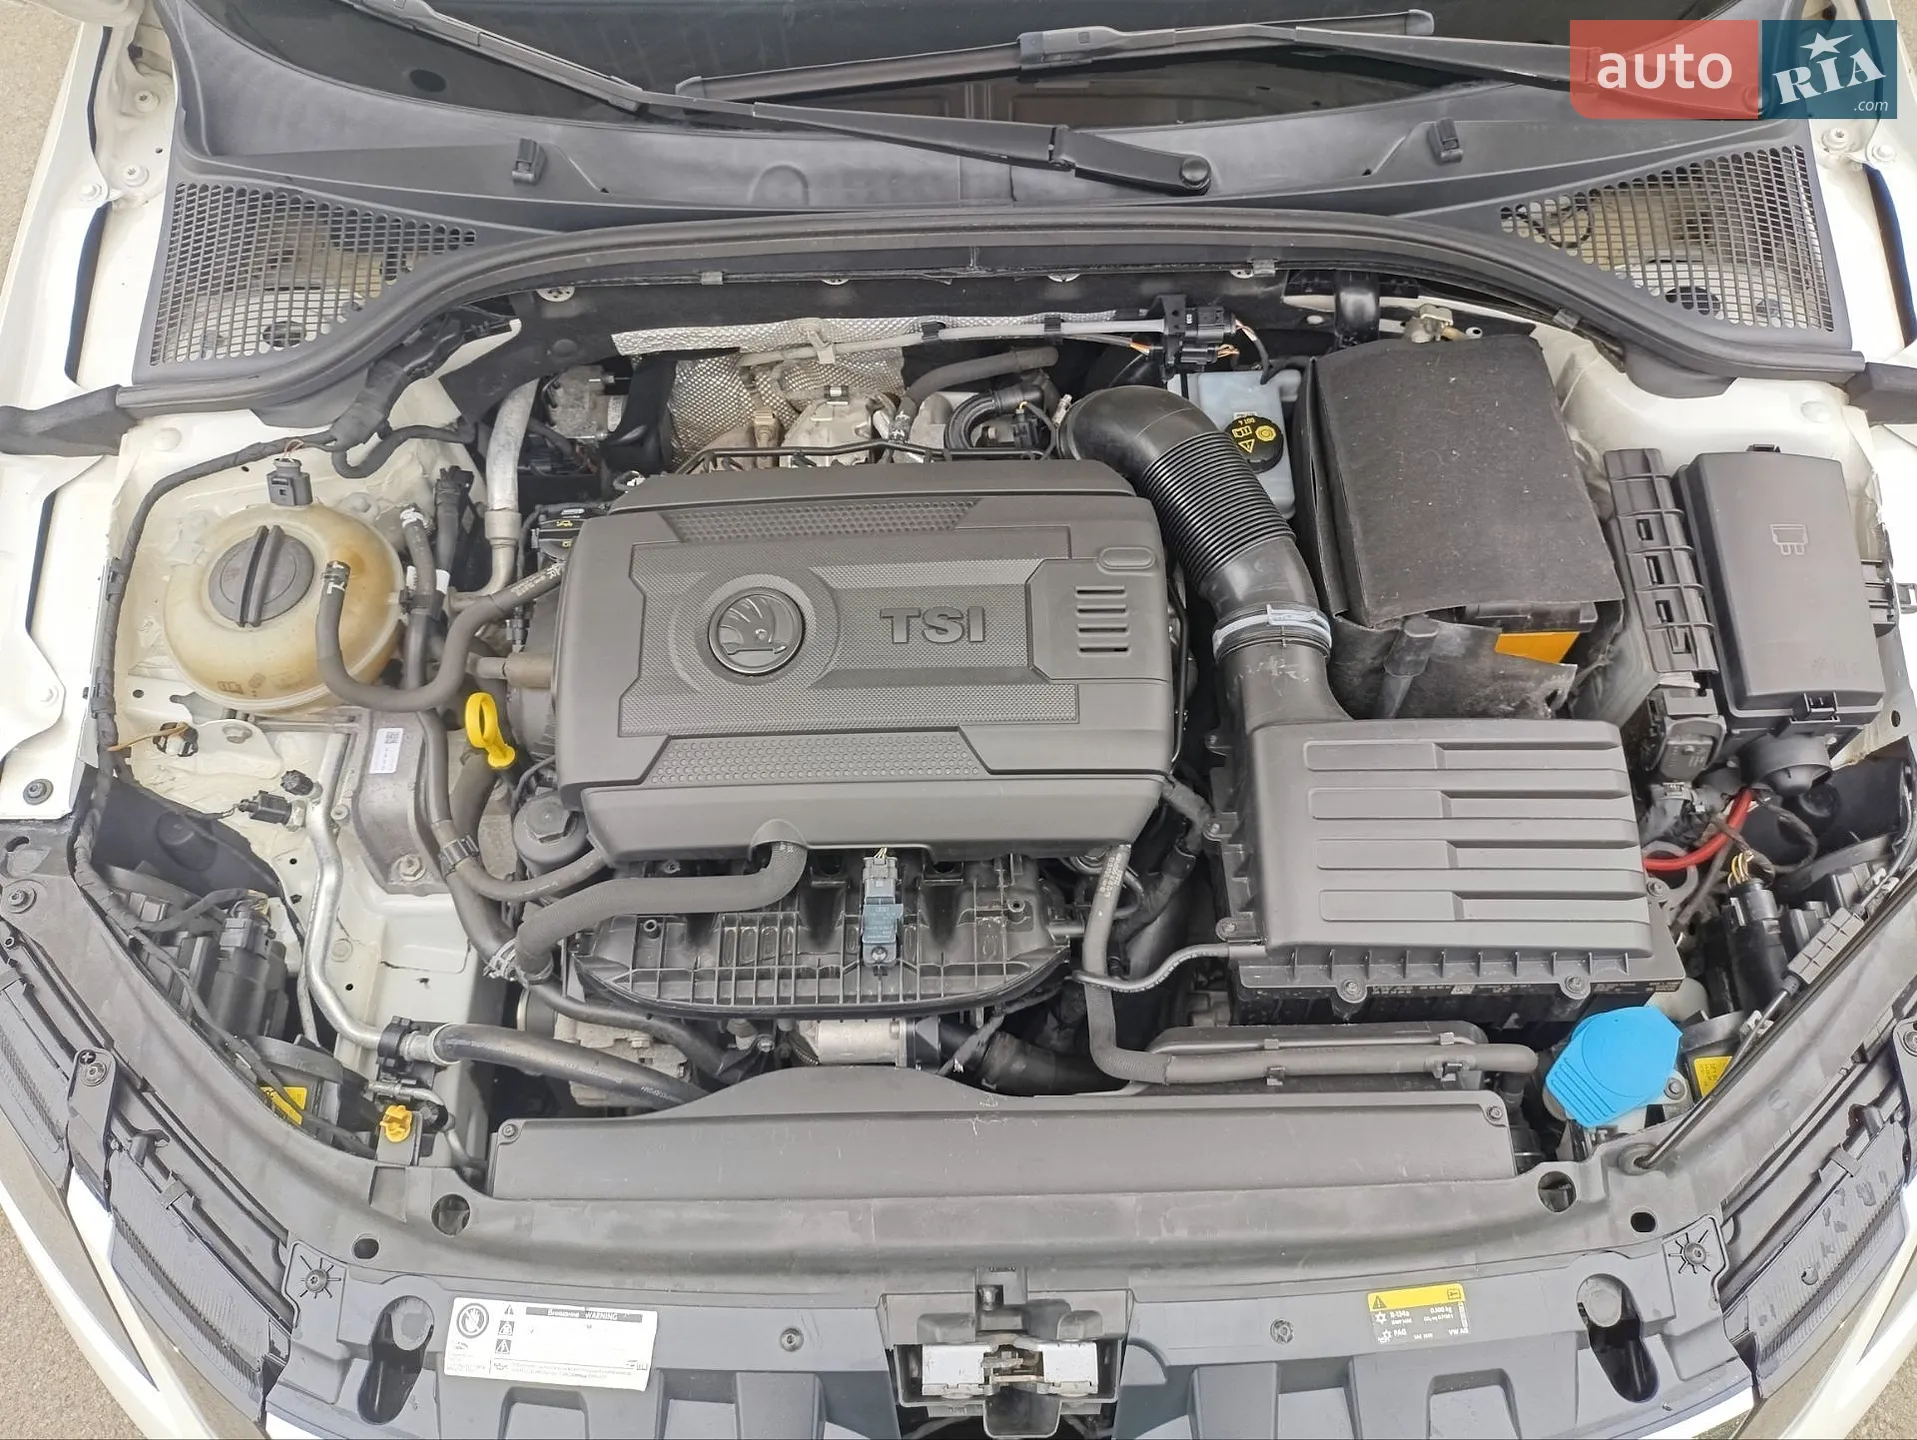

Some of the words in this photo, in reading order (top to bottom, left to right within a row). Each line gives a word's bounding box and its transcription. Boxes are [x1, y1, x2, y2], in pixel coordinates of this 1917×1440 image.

[880, 605, 985, 645] TSI
[585, 1310, 618, 1320] WARNING
[1393, 1328, 1407, 1337] PAG
